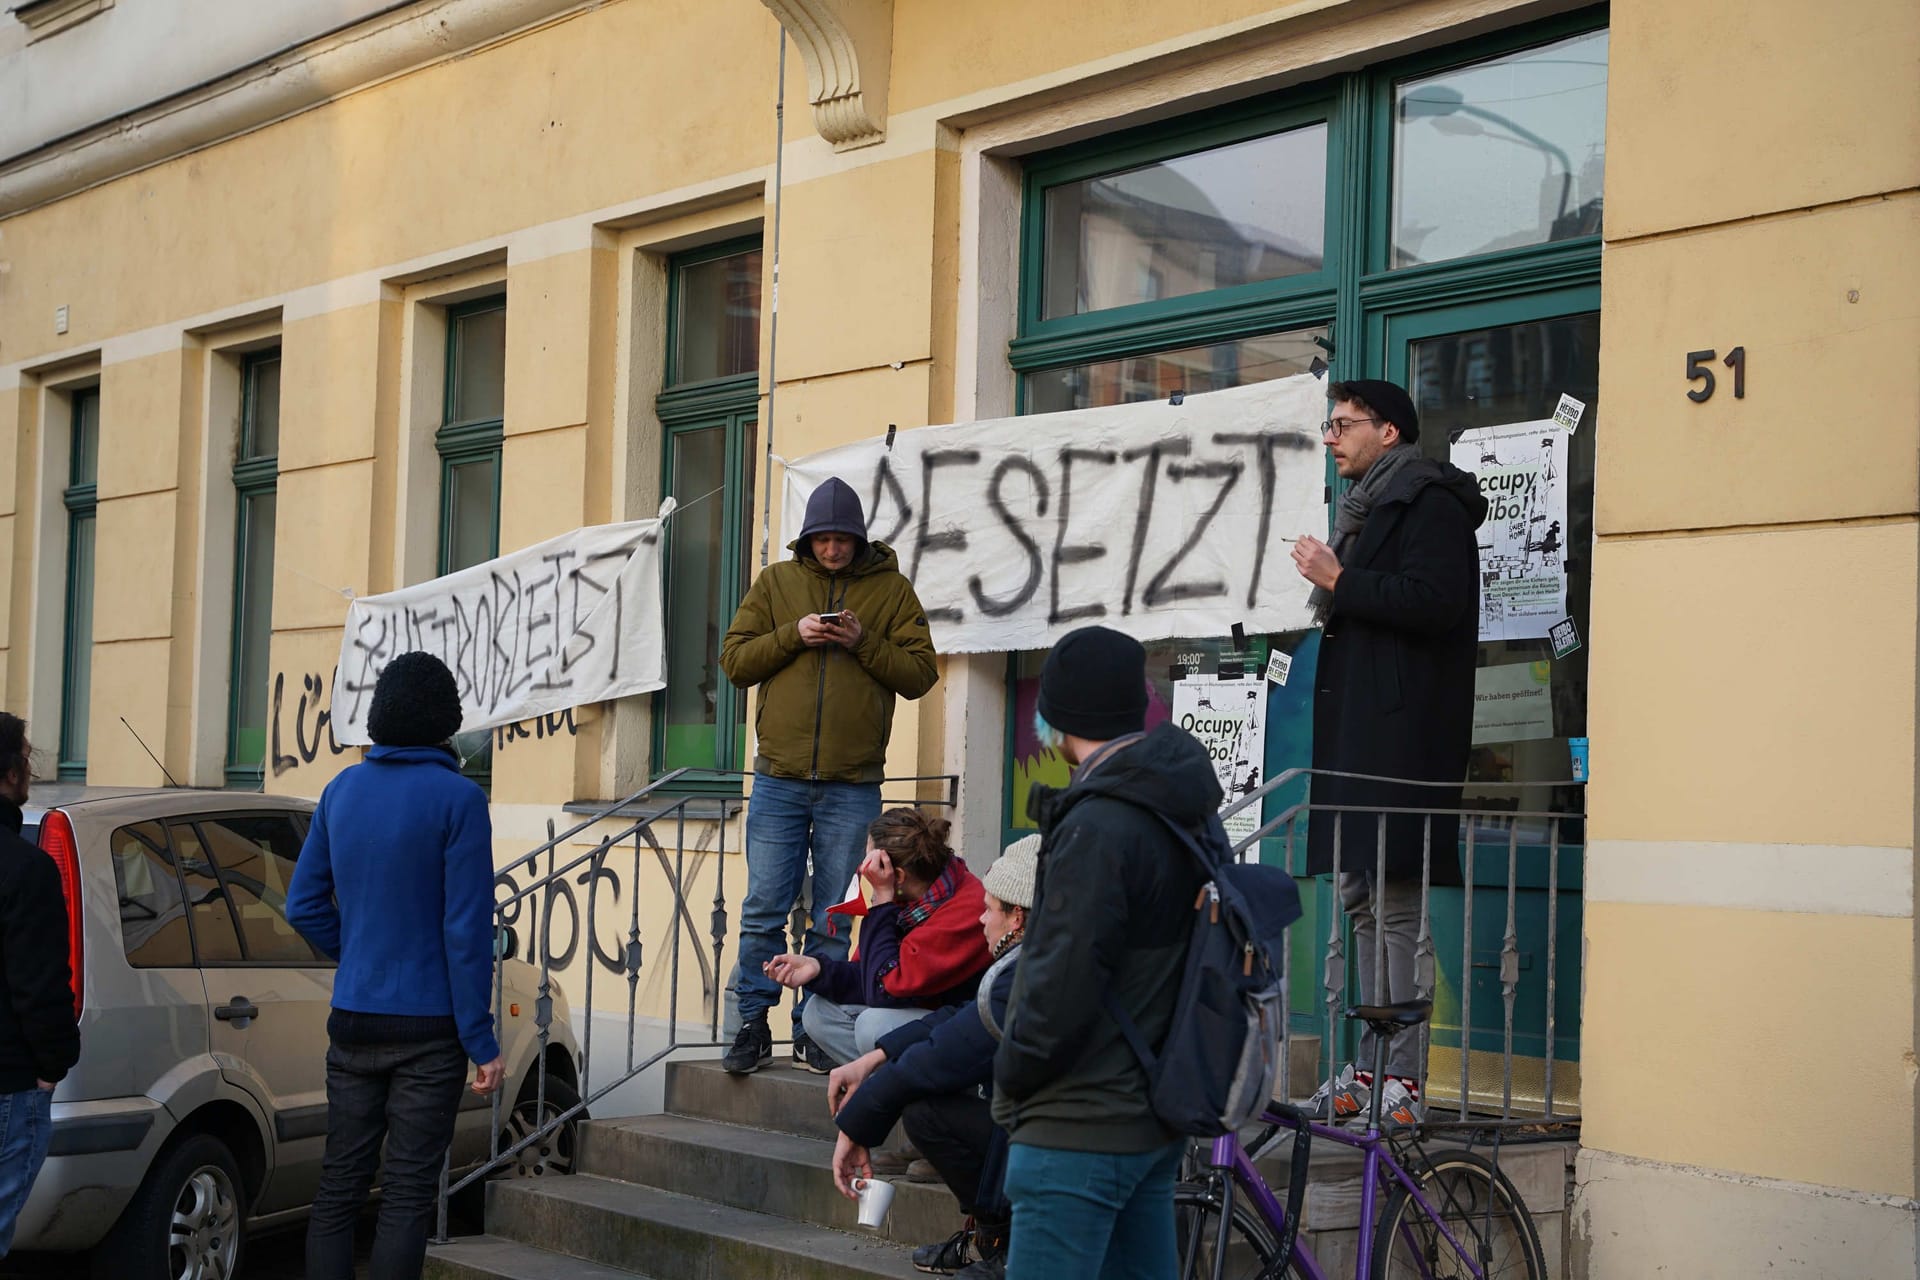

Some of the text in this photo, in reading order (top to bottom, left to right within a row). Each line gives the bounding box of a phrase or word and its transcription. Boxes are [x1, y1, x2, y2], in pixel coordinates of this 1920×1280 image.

[1687, 346, 1744, 403] 51
[1559, 402, 1579, 419] HEIBO
[1554, 411, 1577, 430] BLEIBT
[1478, 471, 1538, 495] ccupy
[1488, 495, 1529, 521] ibo!
[1508, 529, 1526, 540] HOME
[1509, 521, 1527, 532] SWEET
[1552, 621, 1572, 641] HEIBO
[1177, 653, 1200, 665] 19:00
[1271, 657, 1288, 672] HEIBO
[1475, 688, 1543, 702] Wir haben geöffnet!
[1181, 713, 1243, 739] Occupy
